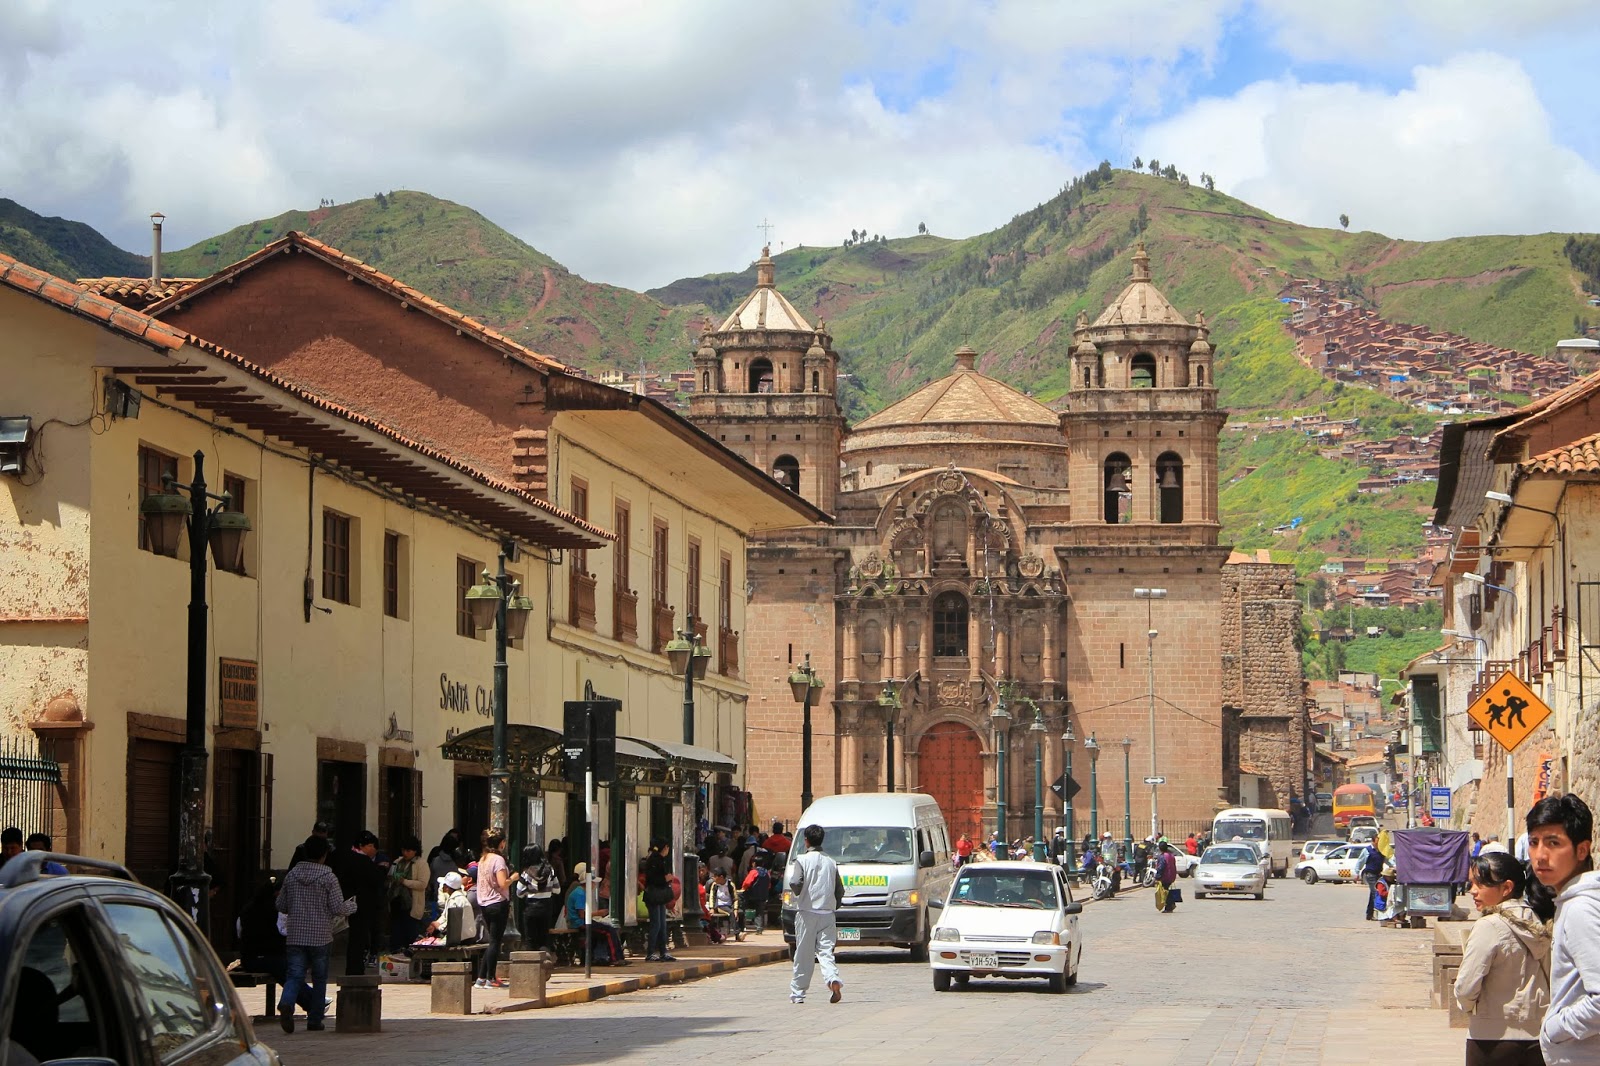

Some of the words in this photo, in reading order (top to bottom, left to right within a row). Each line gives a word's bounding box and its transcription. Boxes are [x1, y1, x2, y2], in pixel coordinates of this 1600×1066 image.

[440, 673, 469, 714] SANTA
[476, 684, 496, 718] CLA
[847, 875, 887, 887] FLORIDA
